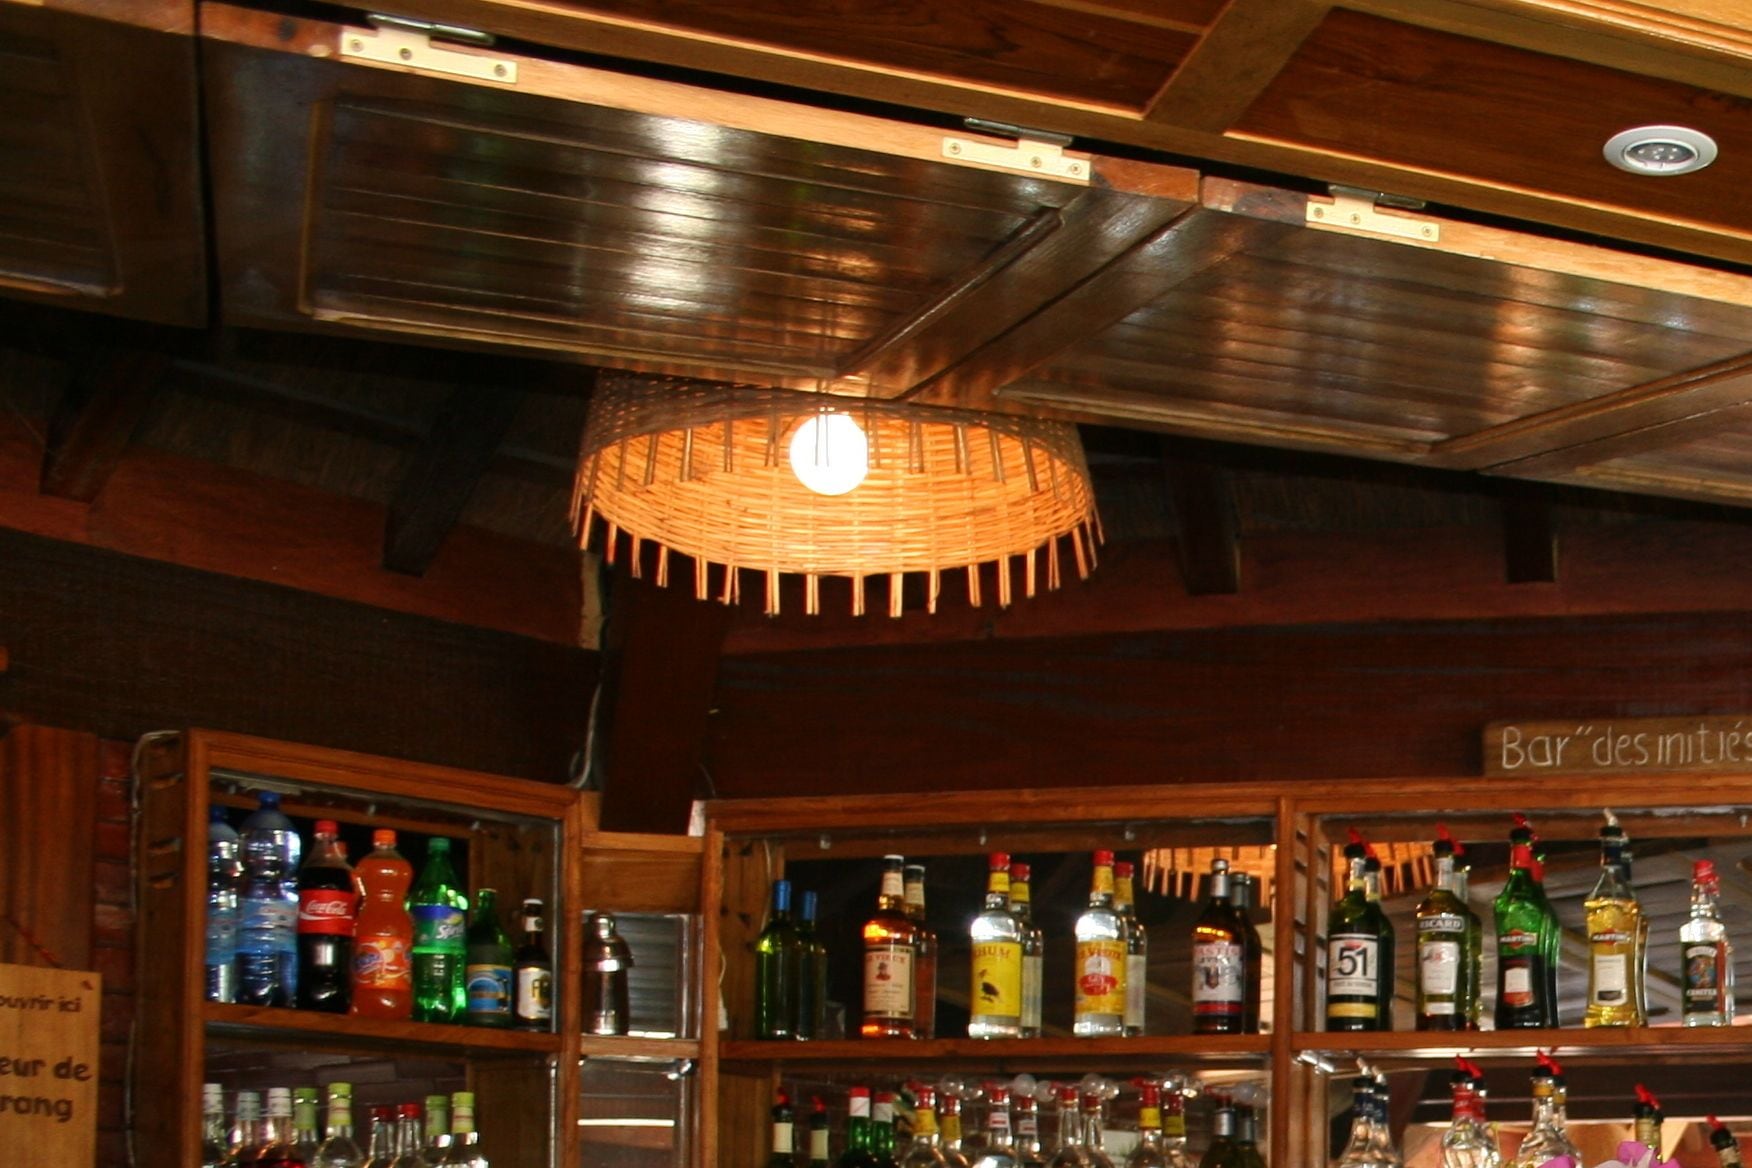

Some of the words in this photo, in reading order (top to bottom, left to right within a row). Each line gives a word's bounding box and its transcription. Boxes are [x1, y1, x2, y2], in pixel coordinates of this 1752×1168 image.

[1501, 725, 1570, 770] Bar
[1337, 946, 1368, 977] 51
[53, 1056, 93, 1082] de
